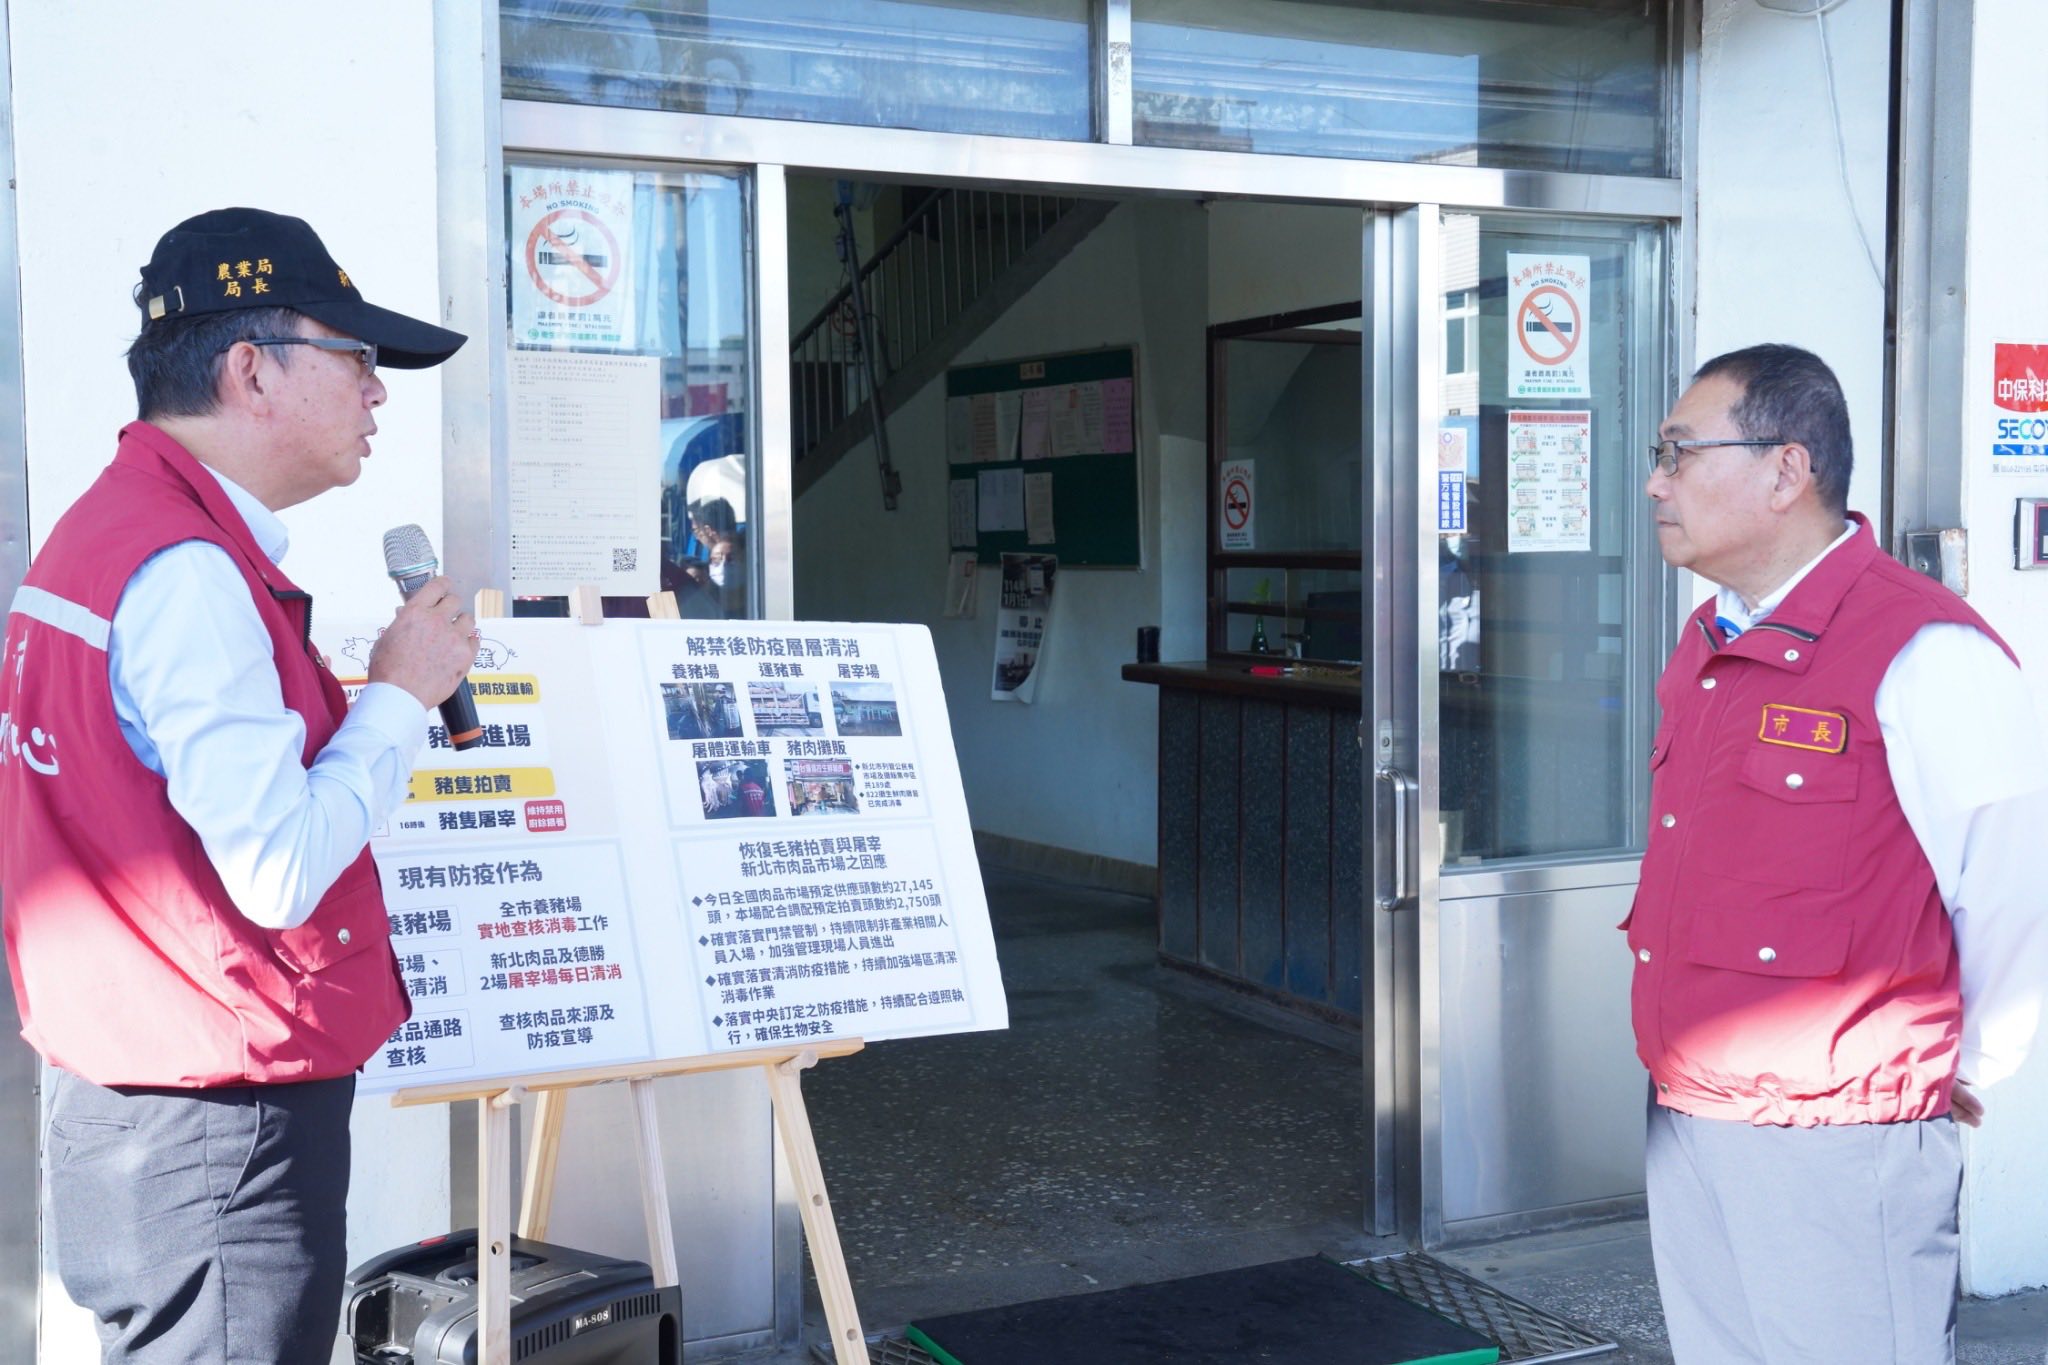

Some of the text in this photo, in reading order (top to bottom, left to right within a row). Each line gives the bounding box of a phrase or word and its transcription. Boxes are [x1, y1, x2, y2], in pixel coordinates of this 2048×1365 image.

[546, 199, 600, 215] NO SMOKING
[216, 258, 273, 280] 農業局
[224, 277, 270, 296] 局長
[1530, 278, 1568, 289] NO SMOKING
[1998, 418, 2048, 440] SECO
[687, 636, 860, 659] 解禁後防疫層層清消
[672, 663, 720, 680] 養豬場
[758, 662, 804, 678] 運豬車
[838, 663, 880, 679] 屠宰場
[428, 724, 531, 750] 豬進場
[1773, 714, 1832, 743] 市長
[692, 740, 772, 759] 屠體運輸車
[787, 740, 847, 757] 豬肉攤販
[434, 774, 512, 796] 豬隻拍賣
[439, 809, 517, 831] 豬隻屠宰
[738, 835, 882, 861] 恢復毛豬拍賣與屠宰
[398, 860, 543, 891] 現有防疫作為
[740, 853, 888, 878] 新北市肉品市場之因應
[499, 896, 582, 918] 全市養豬場
[477, 915, 608, 941] 實地查核消毒工作
[490, 945, 605, 969] 新北肉品及德勝
[714, 935, 895, 965] 員入場，加強管理現場人員進出
[405, 976, 448, 998] 清消
[480, 963, 622, 991] 2場屠宰場每日清消
[721, 985, 776, 1005] 消毒作業
[499, 1004, 615, 1031] 查核肉品來源及
[527, 1027, 593, 1049] 防疫宣導
[727, 1020, 834, 1045] 行，確保生物安全
[387, 1046, 427, 1068] 查核
